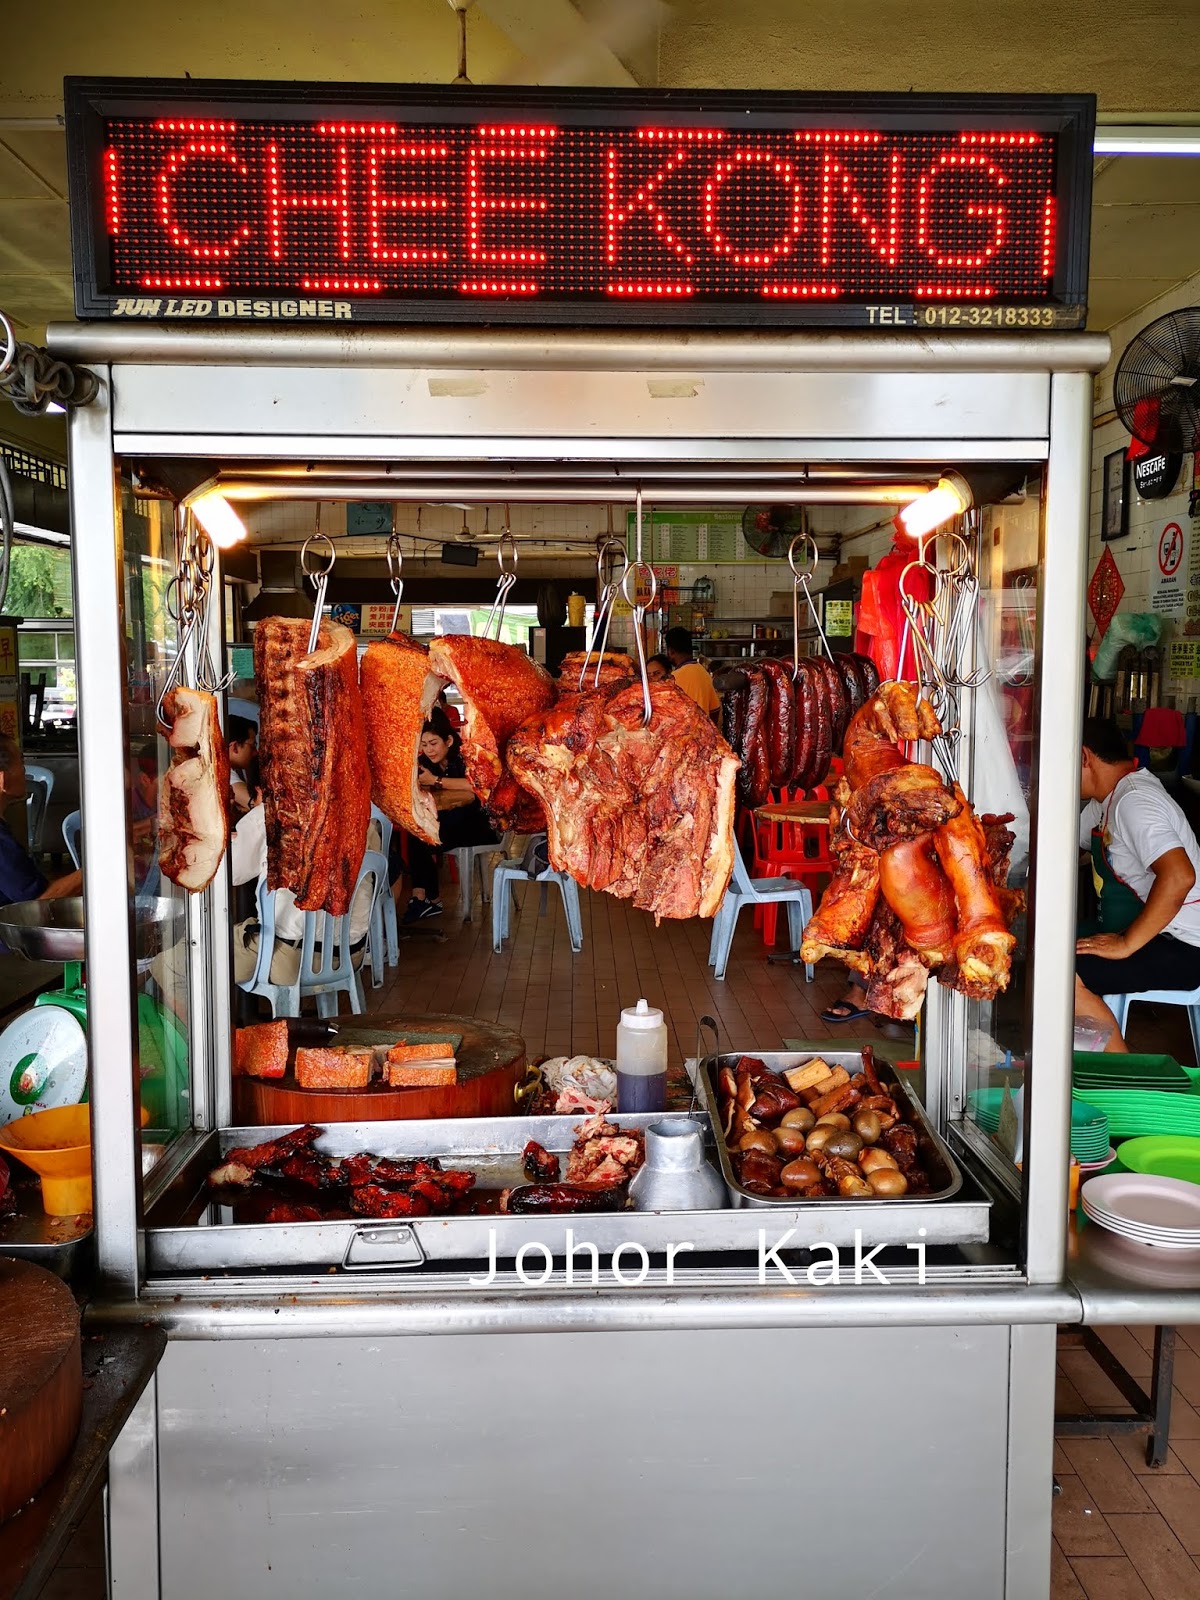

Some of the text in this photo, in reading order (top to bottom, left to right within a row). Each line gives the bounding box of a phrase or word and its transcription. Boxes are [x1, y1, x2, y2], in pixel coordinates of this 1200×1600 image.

[159, 143, 1006, 268] CHEE KONG
[112, 298, 353, 319] JUN LED DESIGNER
[924, 306, 1055, 326] 012-3218333
[333, 611, 360, 625] Tiger
